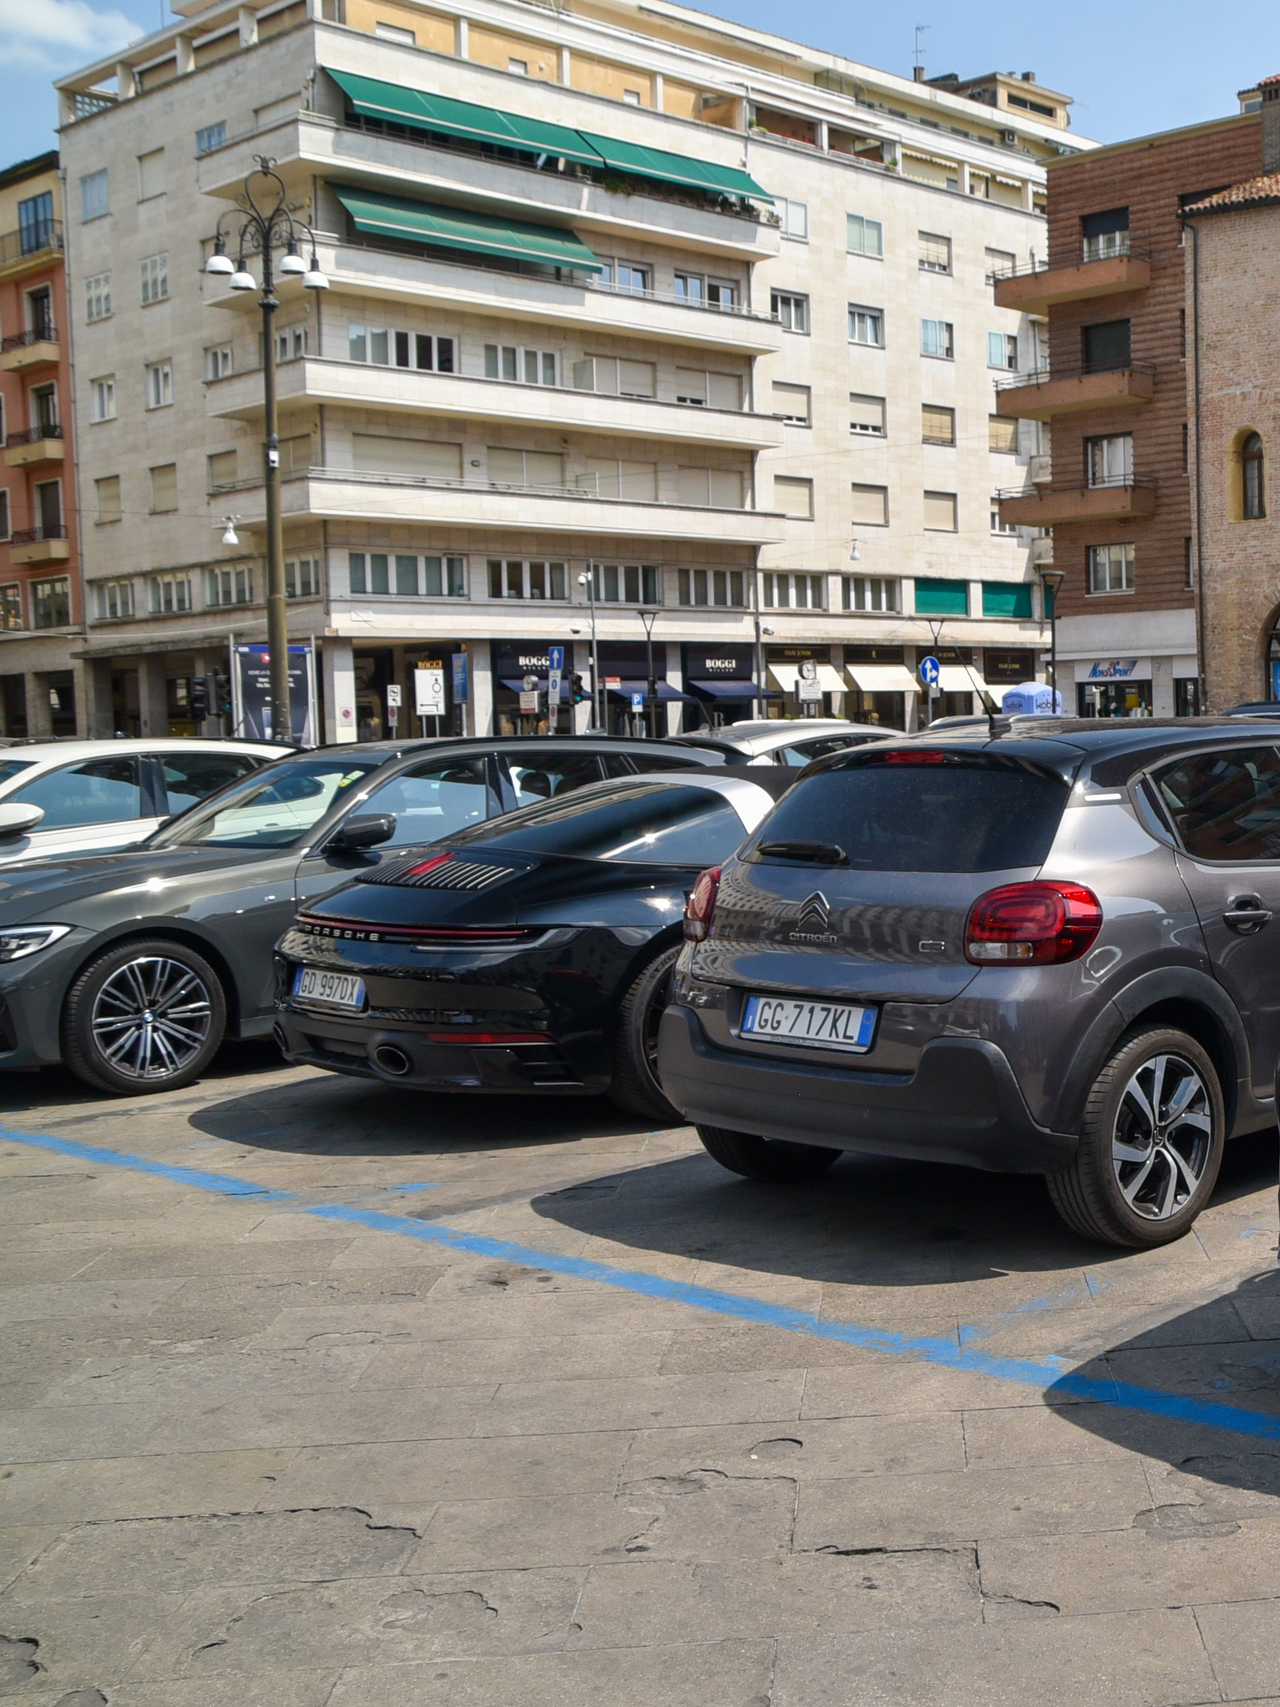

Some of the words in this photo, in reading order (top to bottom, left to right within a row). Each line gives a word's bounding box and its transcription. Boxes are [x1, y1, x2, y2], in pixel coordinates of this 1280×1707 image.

[518, 655, 550, 666] BOGG
[705, 658, 737, 669] BOGGI
[305, 924, 380, 942] PORSCHE
